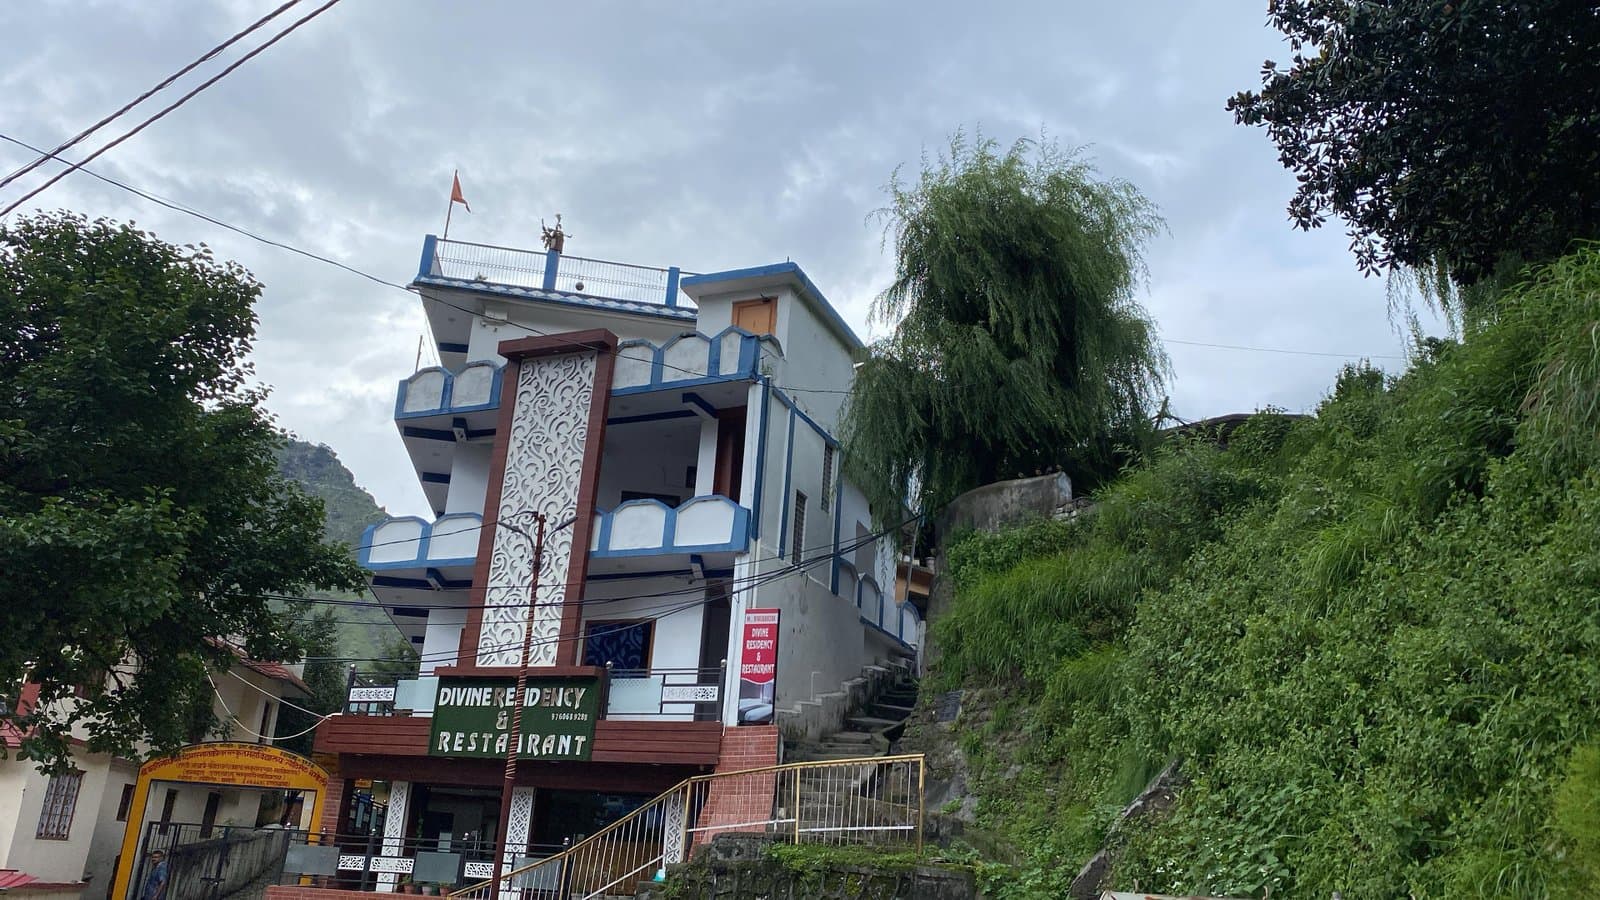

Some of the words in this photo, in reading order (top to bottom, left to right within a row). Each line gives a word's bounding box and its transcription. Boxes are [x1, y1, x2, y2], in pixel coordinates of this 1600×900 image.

[751, 628, 769, 638] DIVINE
[746, 640, 773, 650] RESIDENCY
[742, 664, 775, 675] RESTAURANT
[438, 687, 493, 707] DIVINE
[495, 710, 509, 730] &
